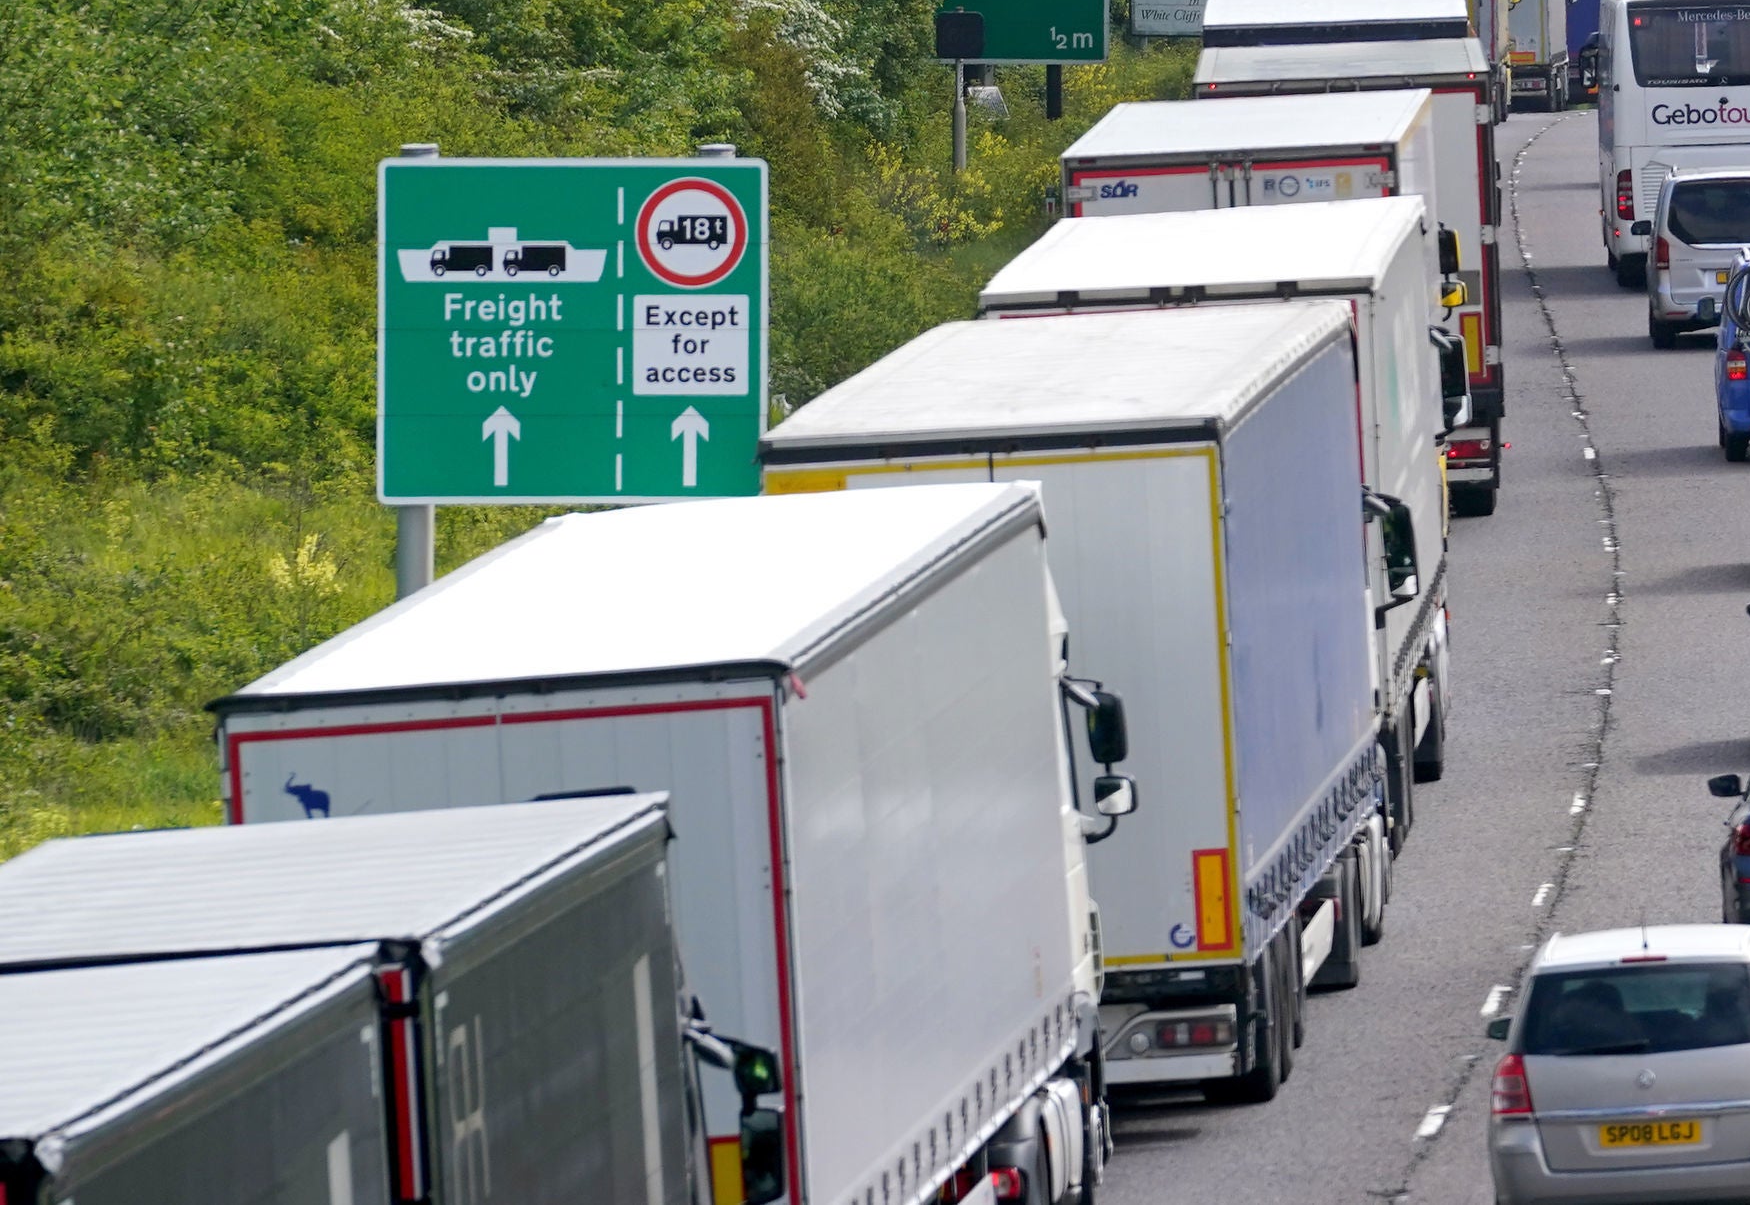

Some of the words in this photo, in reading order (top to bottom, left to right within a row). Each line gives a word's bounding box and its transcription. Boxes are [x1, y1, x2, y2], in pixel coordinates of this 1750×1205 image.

[1142, 9, 1170, 20] White
[1072, 32, 1094, 49] m
[444, 293, 562, 327] Freight
[645, 305, 739, 331] Except
[450, 330, 553, 358] traffic
[672, 334, 709, 354] for
[466, 365, 536, 397] only
[646, 365, 737, 383] access
